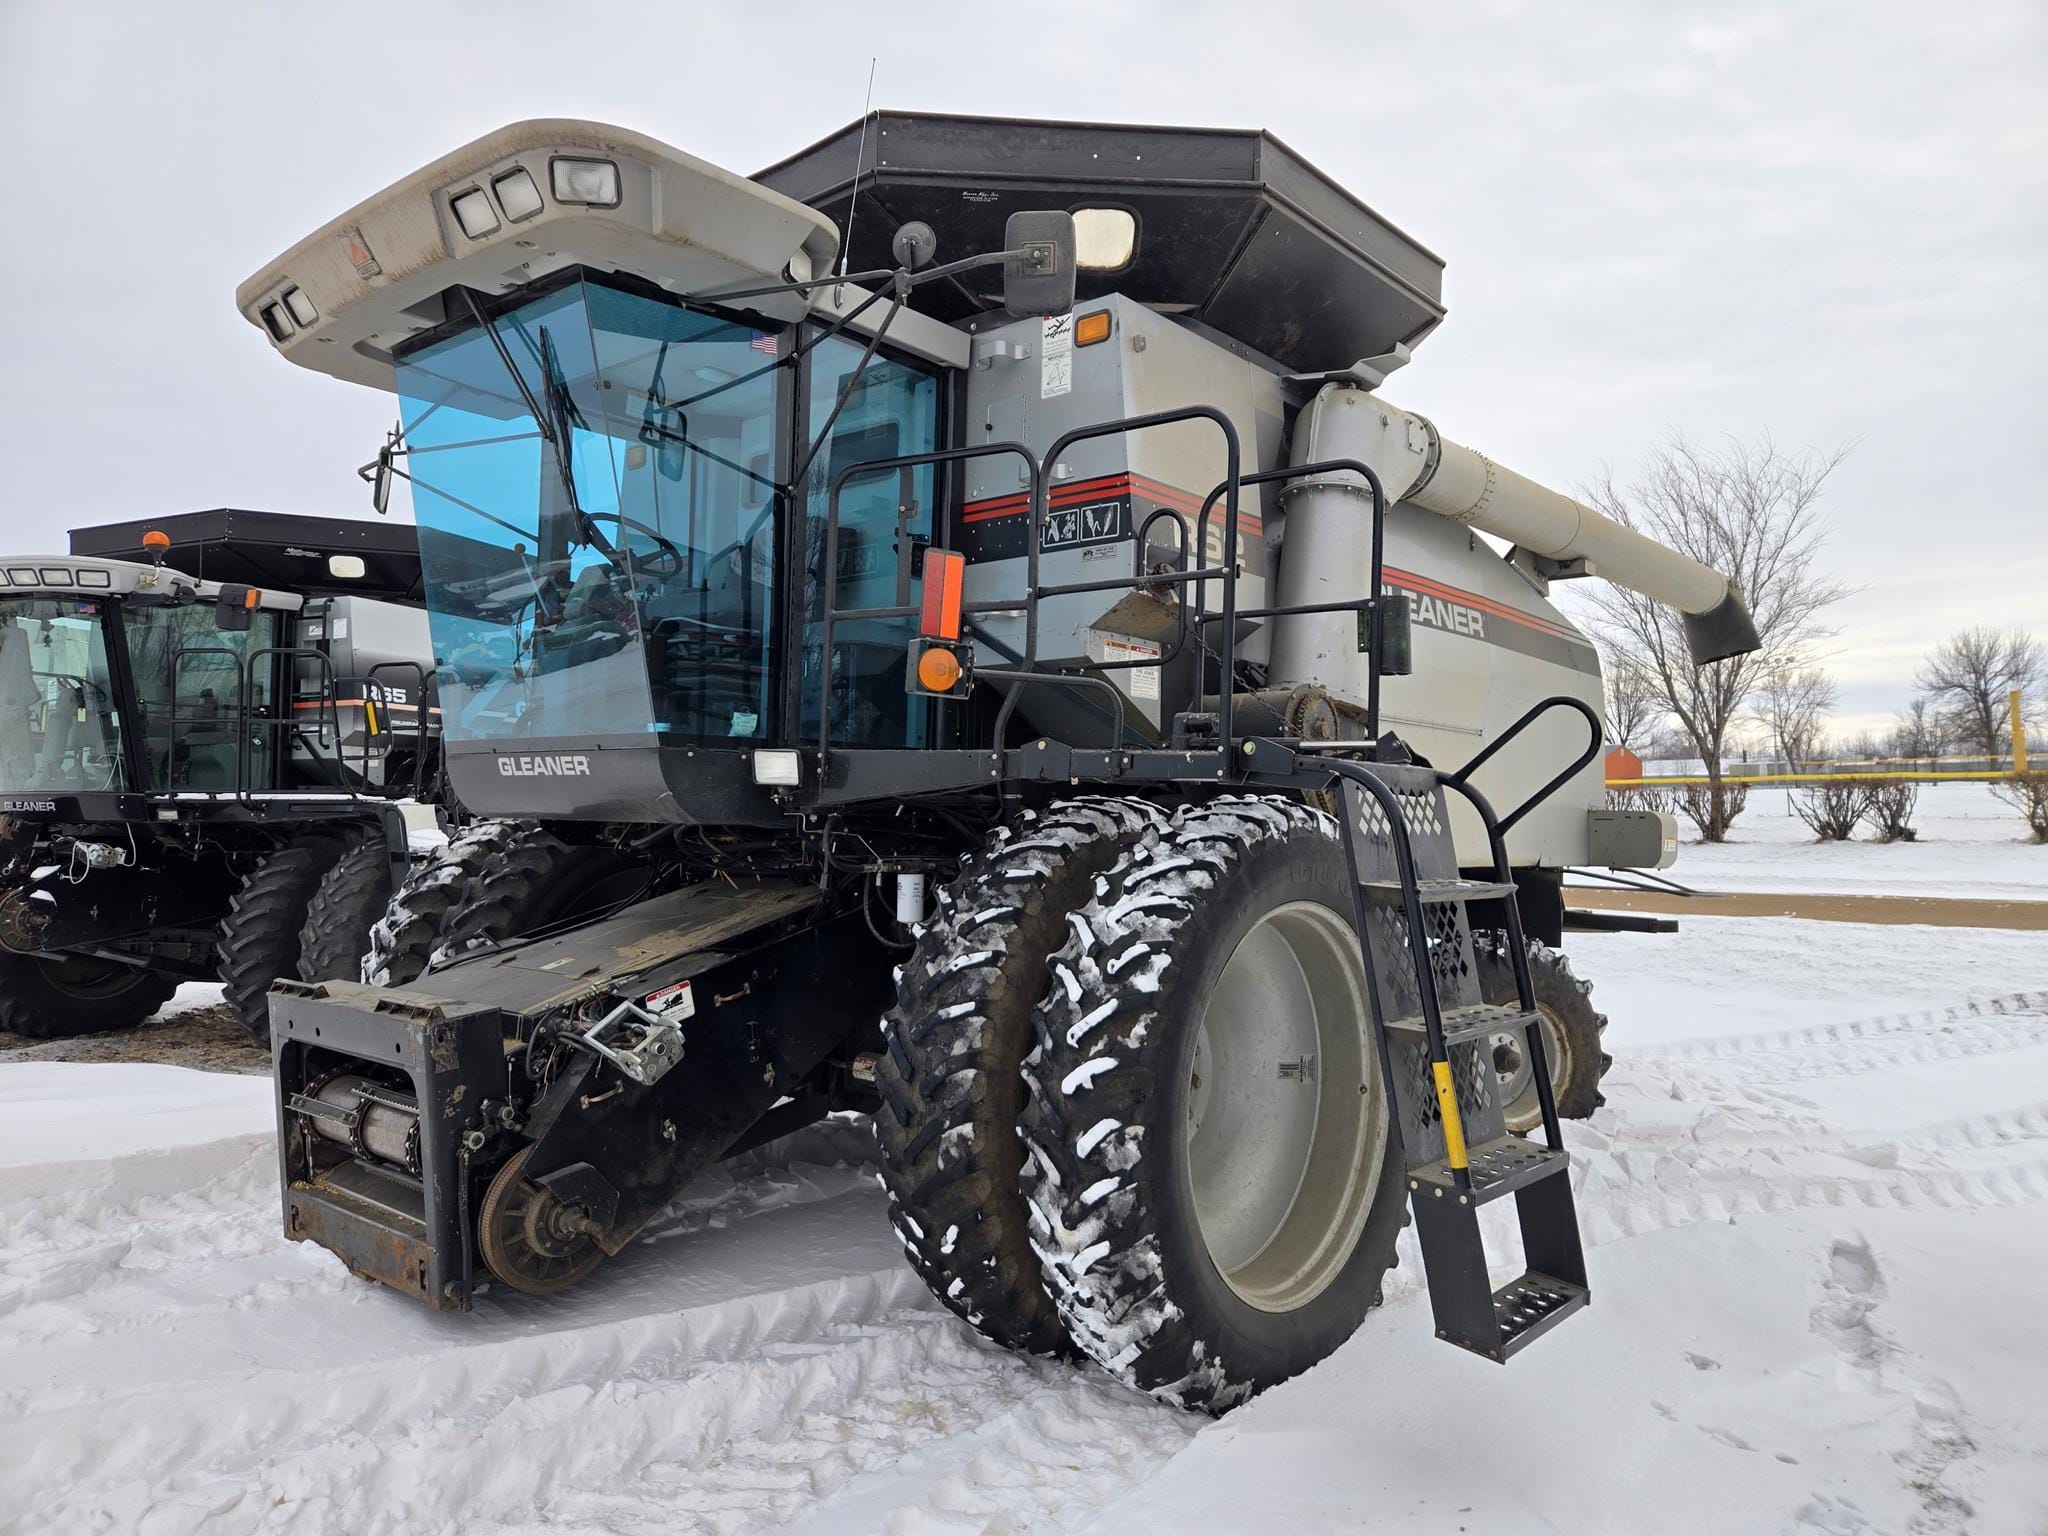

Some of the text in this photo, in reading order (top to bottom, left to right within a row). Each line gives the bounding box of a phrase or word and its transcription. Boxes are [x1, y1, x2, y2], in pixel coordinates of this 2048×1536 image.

[1381, 583, 1485, 638] EANER
[498, 755, 591, 776] GLEANER
[3, 801, 57, 811] GLEANER
